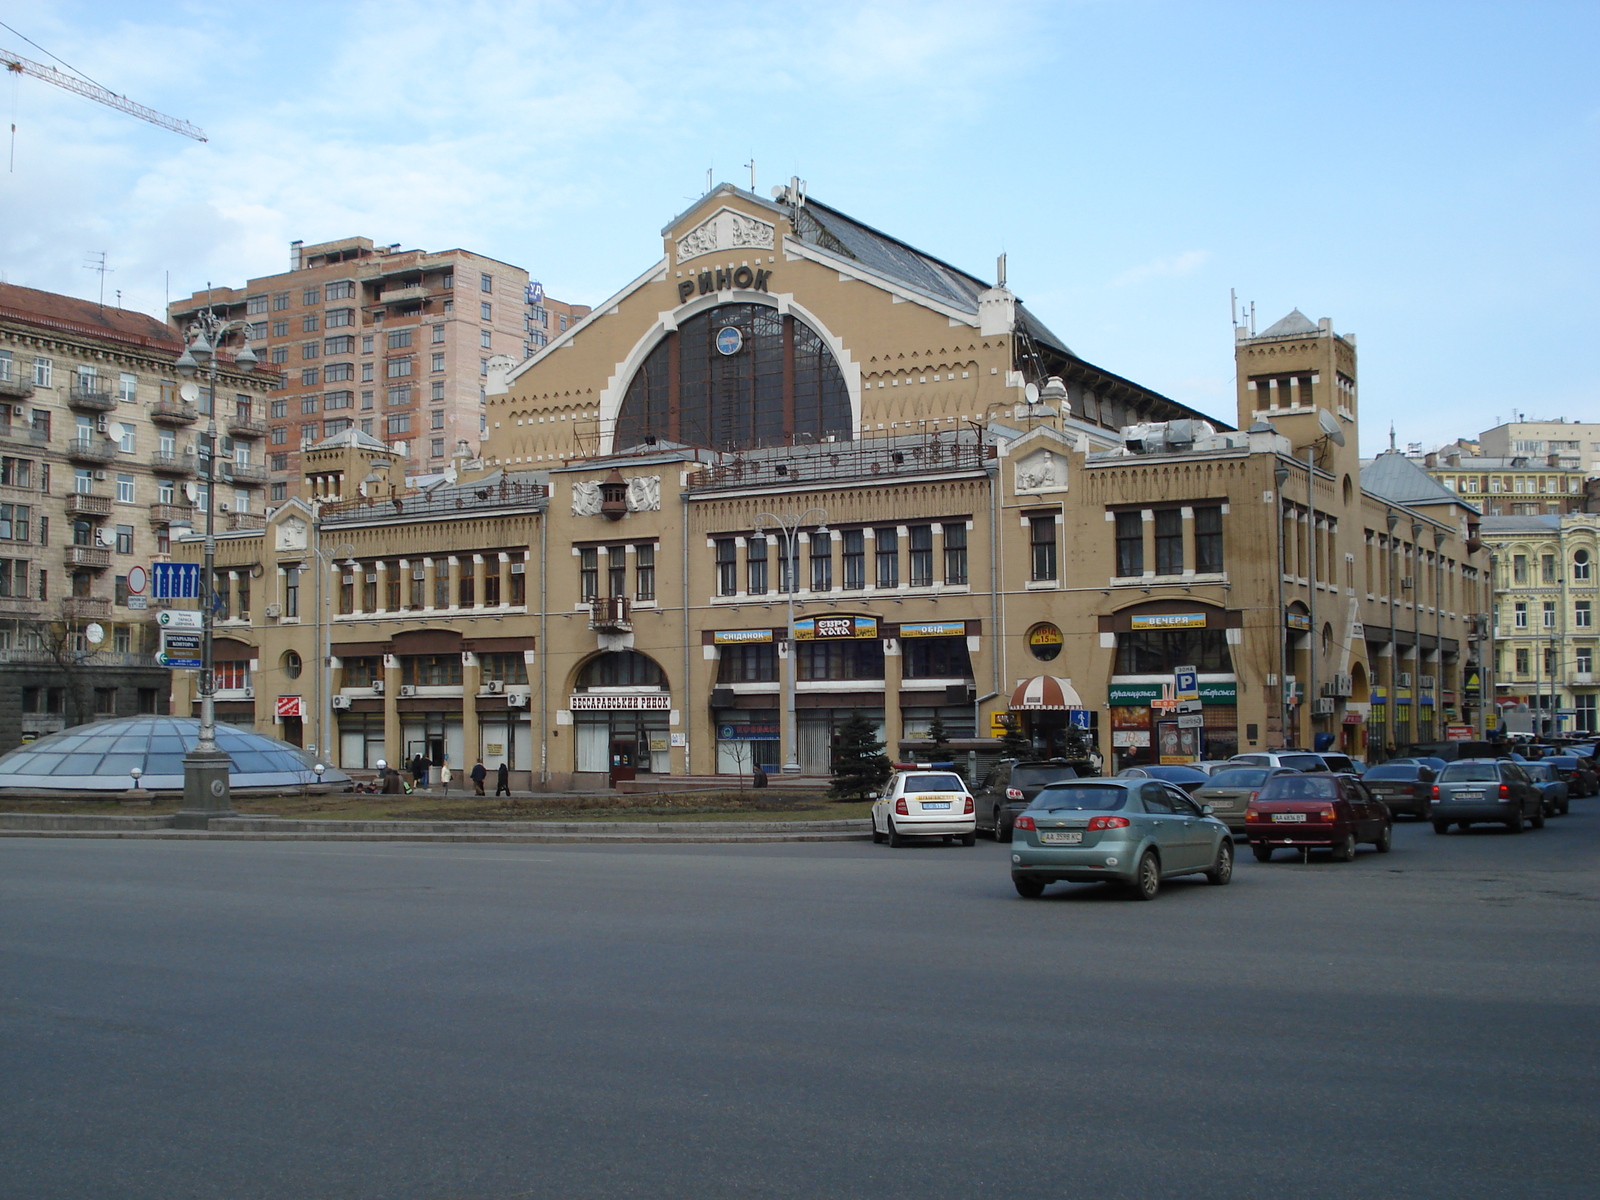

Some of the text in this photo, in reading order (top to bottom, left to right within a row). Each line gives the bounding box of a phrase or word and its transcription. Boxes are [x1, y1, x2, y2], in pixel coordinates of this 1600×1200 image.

[677, 265, 772, 304] РИНОК
[818, 620, 850, 628] ЄВРО
[1149, 617, 1188, 625] ВЕЧЕРЯ
[819, 626, 850, 636] ХАТА
[723, 632, 764, 641] СНІДАНОК
[1040, 635, 1049, 643] 15
[1180, 675, 1193, 689] P
[1110, 690, 1157, 699] французька
[572, 697, 668, 709] БЕССАРАБСЬКИЙ РИНОК
